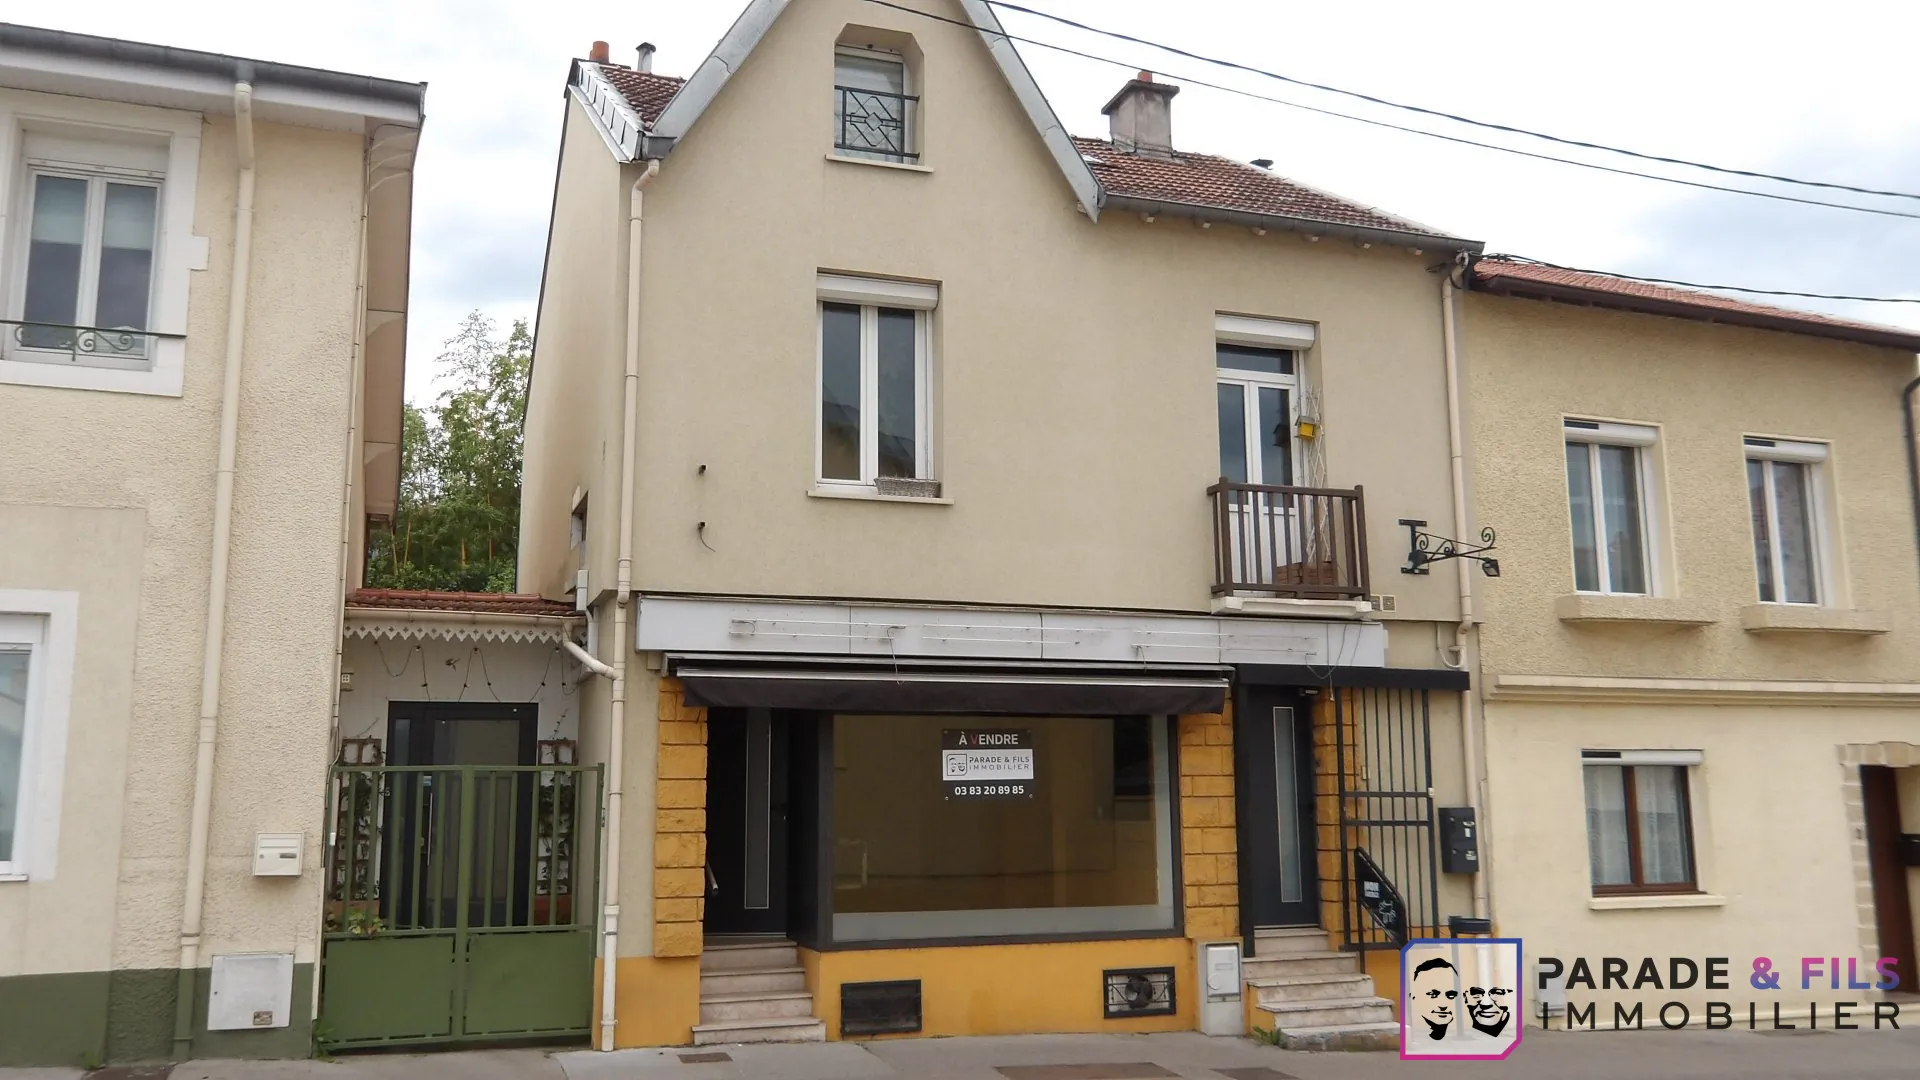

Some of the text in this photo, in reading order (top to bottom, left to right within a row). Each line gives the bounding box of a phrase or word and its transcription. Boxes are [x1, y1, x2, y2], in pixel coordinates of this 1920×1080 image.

[959, 731, 1019, 745] À VENDRE
[954, 785, 1024, 795] 03 83 20 89 85
